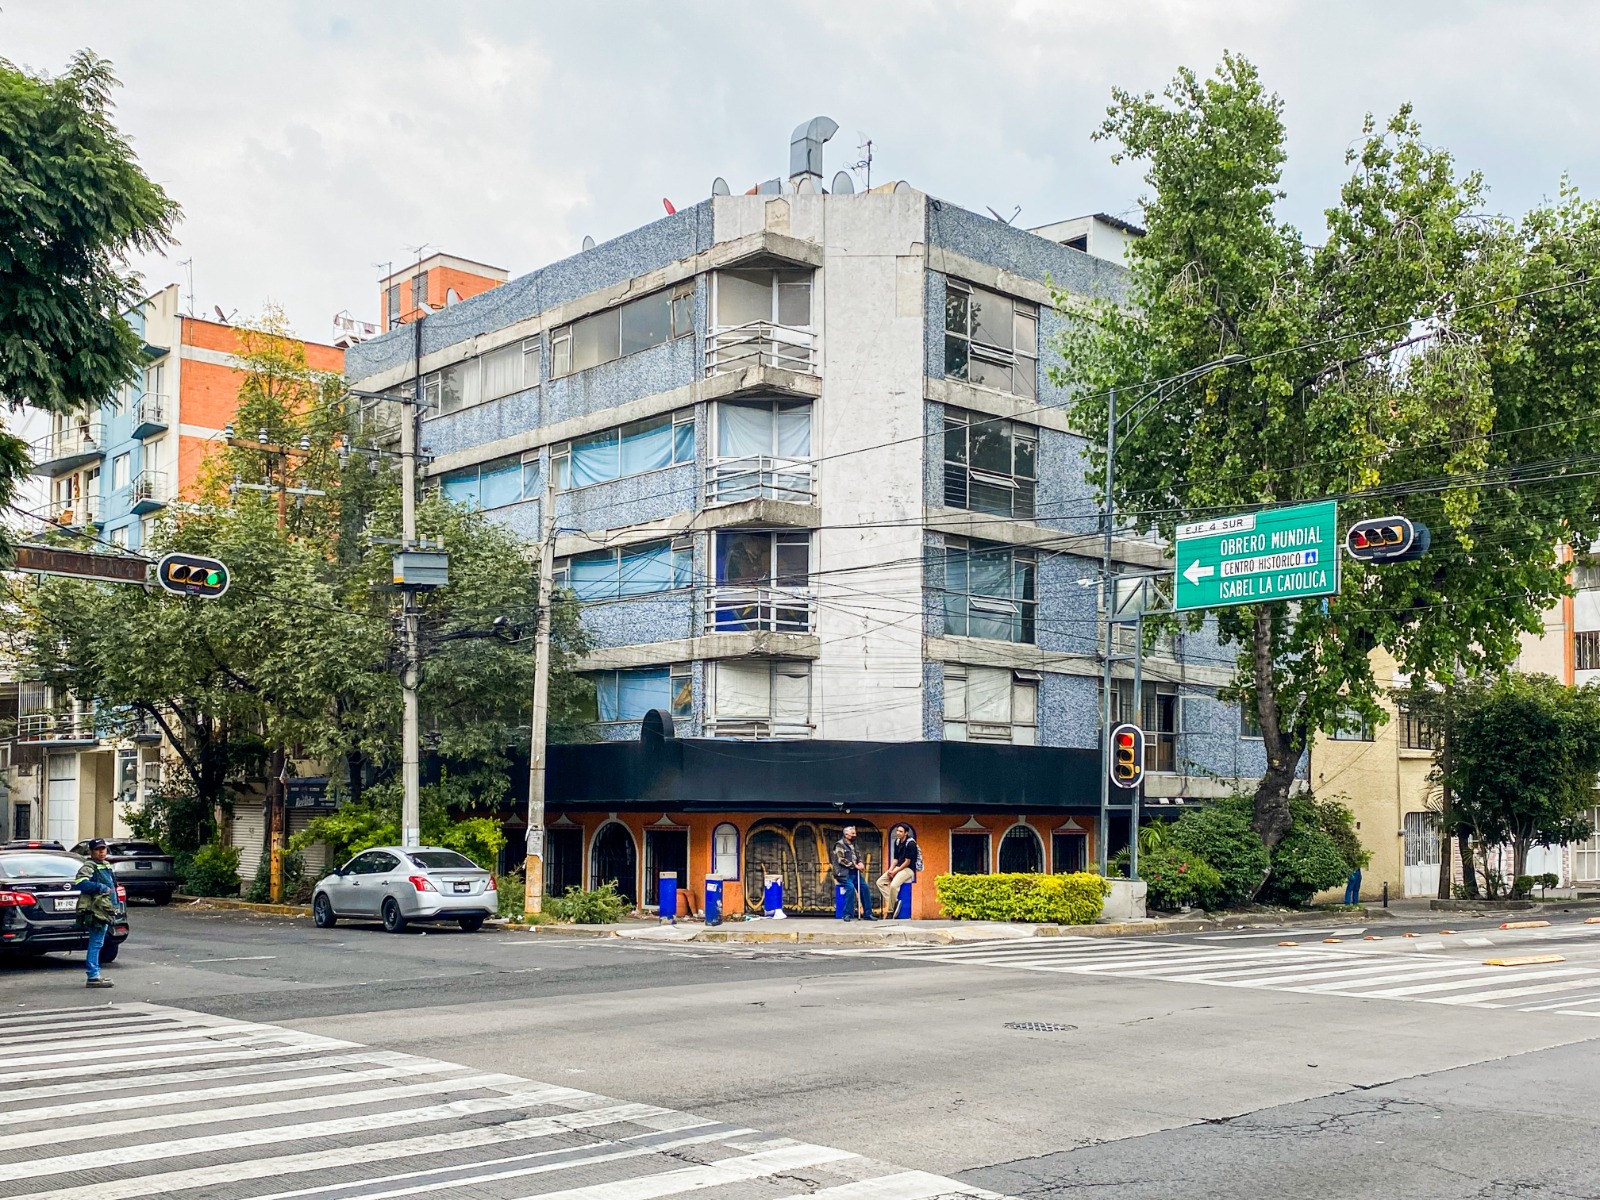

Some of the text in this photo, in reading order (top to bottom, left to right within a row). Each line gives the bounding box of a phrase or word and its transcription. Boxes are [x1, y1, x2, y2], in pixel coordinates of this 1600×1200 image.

[1185, 519, 1243, 535] EJE 4 SUR
[1220, 525, 1323, 556] OBRERO MUNDIAL
[1224, 552, 1301, 575] CENTRO HISTORICO
[1219, 569, 1327, 599] ISABEL LA CATOLICA
